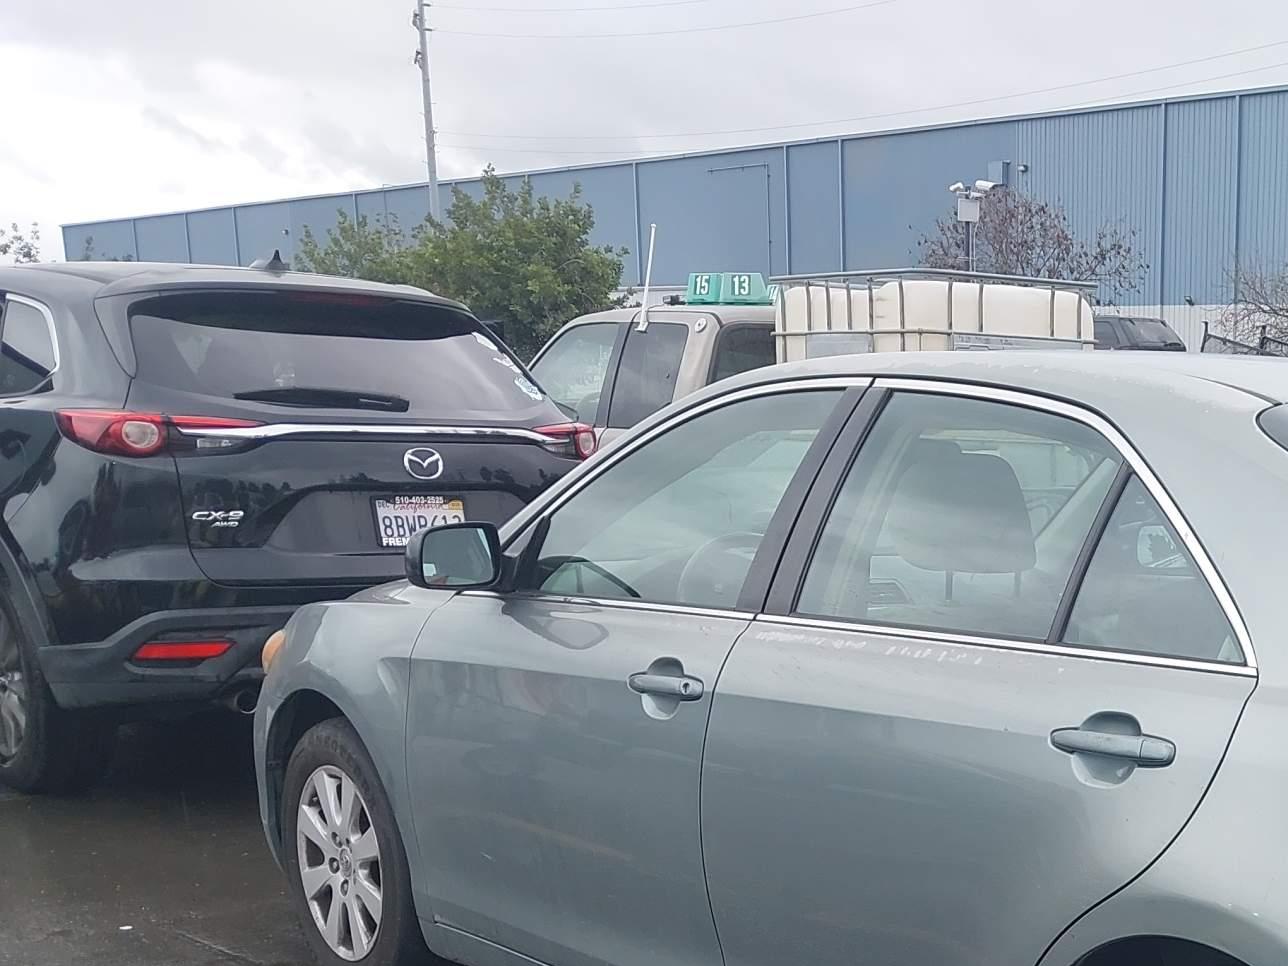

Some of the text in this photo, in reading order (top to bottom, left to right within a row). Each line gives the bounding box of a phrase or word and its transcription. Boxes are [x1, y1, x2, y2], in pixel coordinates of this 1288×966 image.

[694, 275, 710, 296] 15
[732, 275, 750, 296] 13
[191, 510, 244, 521] CX-9
